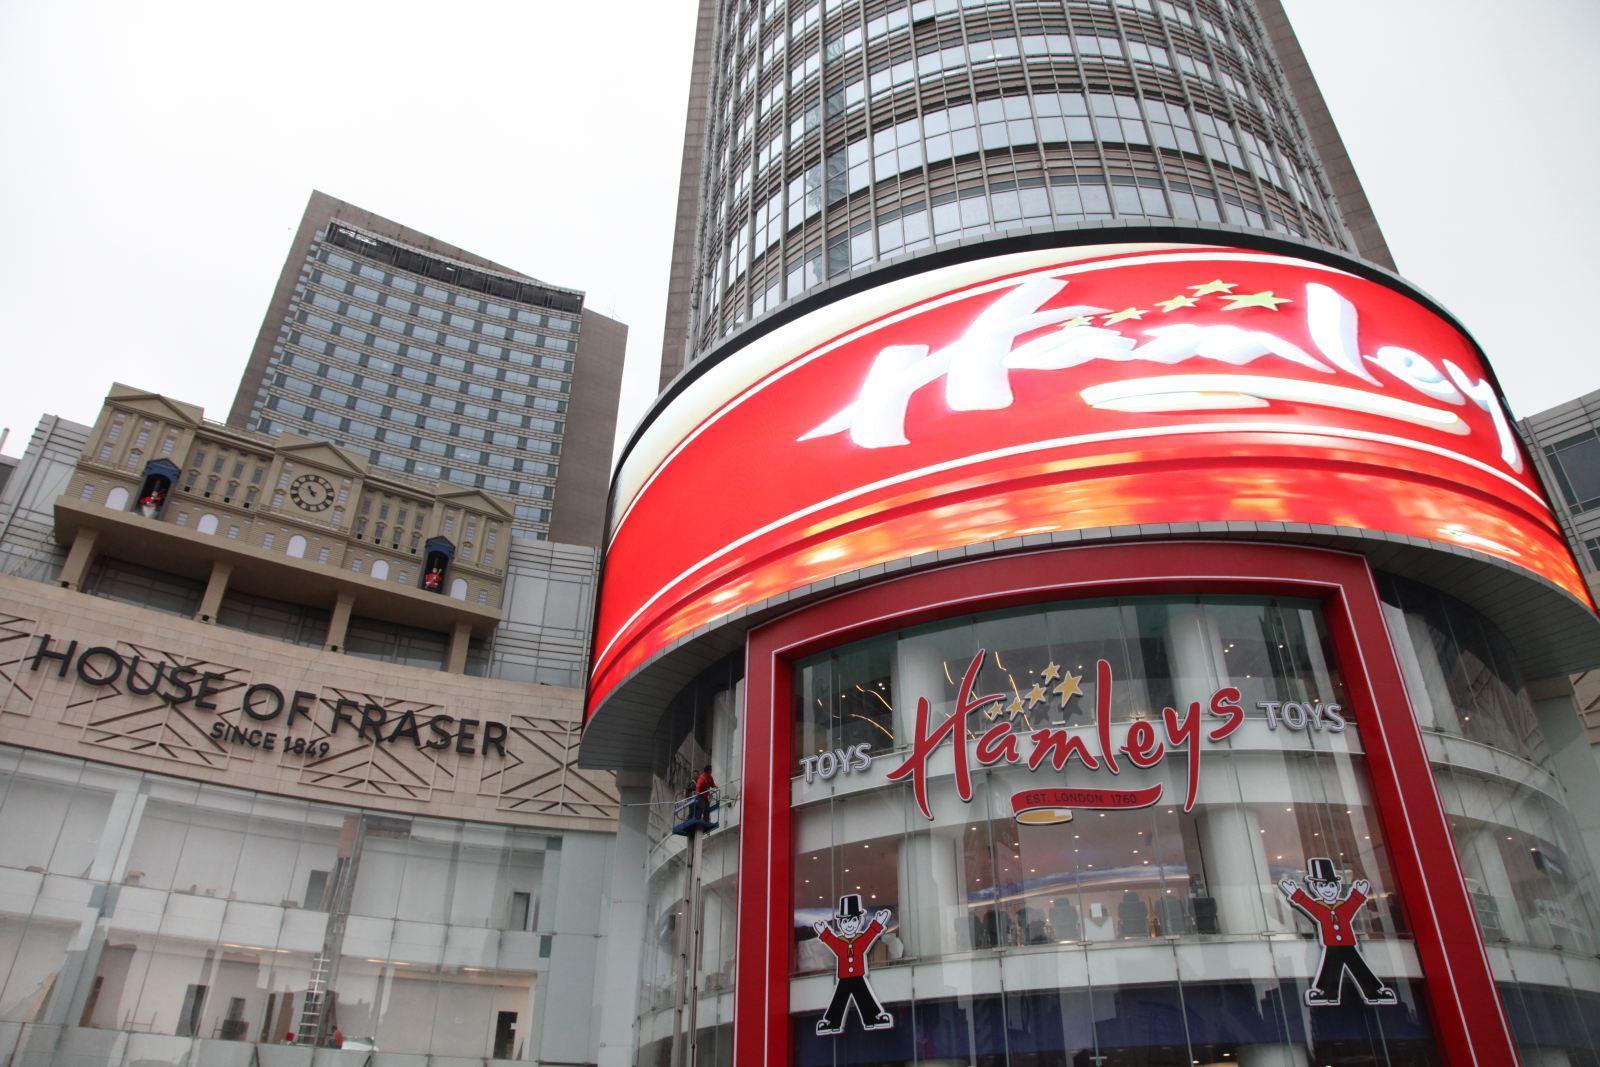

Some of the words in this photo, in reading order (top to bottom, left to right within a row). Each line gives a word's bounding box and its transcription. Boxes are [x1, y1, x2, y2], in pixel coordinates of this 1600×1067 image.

[31, 633, 225, 711] HOUSE
[242, 682, 316, 727] OF
[330, 699, 508, 757] FRASER
[885, 648, 1245, 821] Hamleys
[1256, 701, 1346, 732] TOYS
[209, 721, 277, 750] SINCE
[283, 736, 330, 758] 1849
[799, 742, 872, 784] TOYS
[1054, 793, 1104, 803] LONDON
[1110, 793, 1137, 804] 1760
